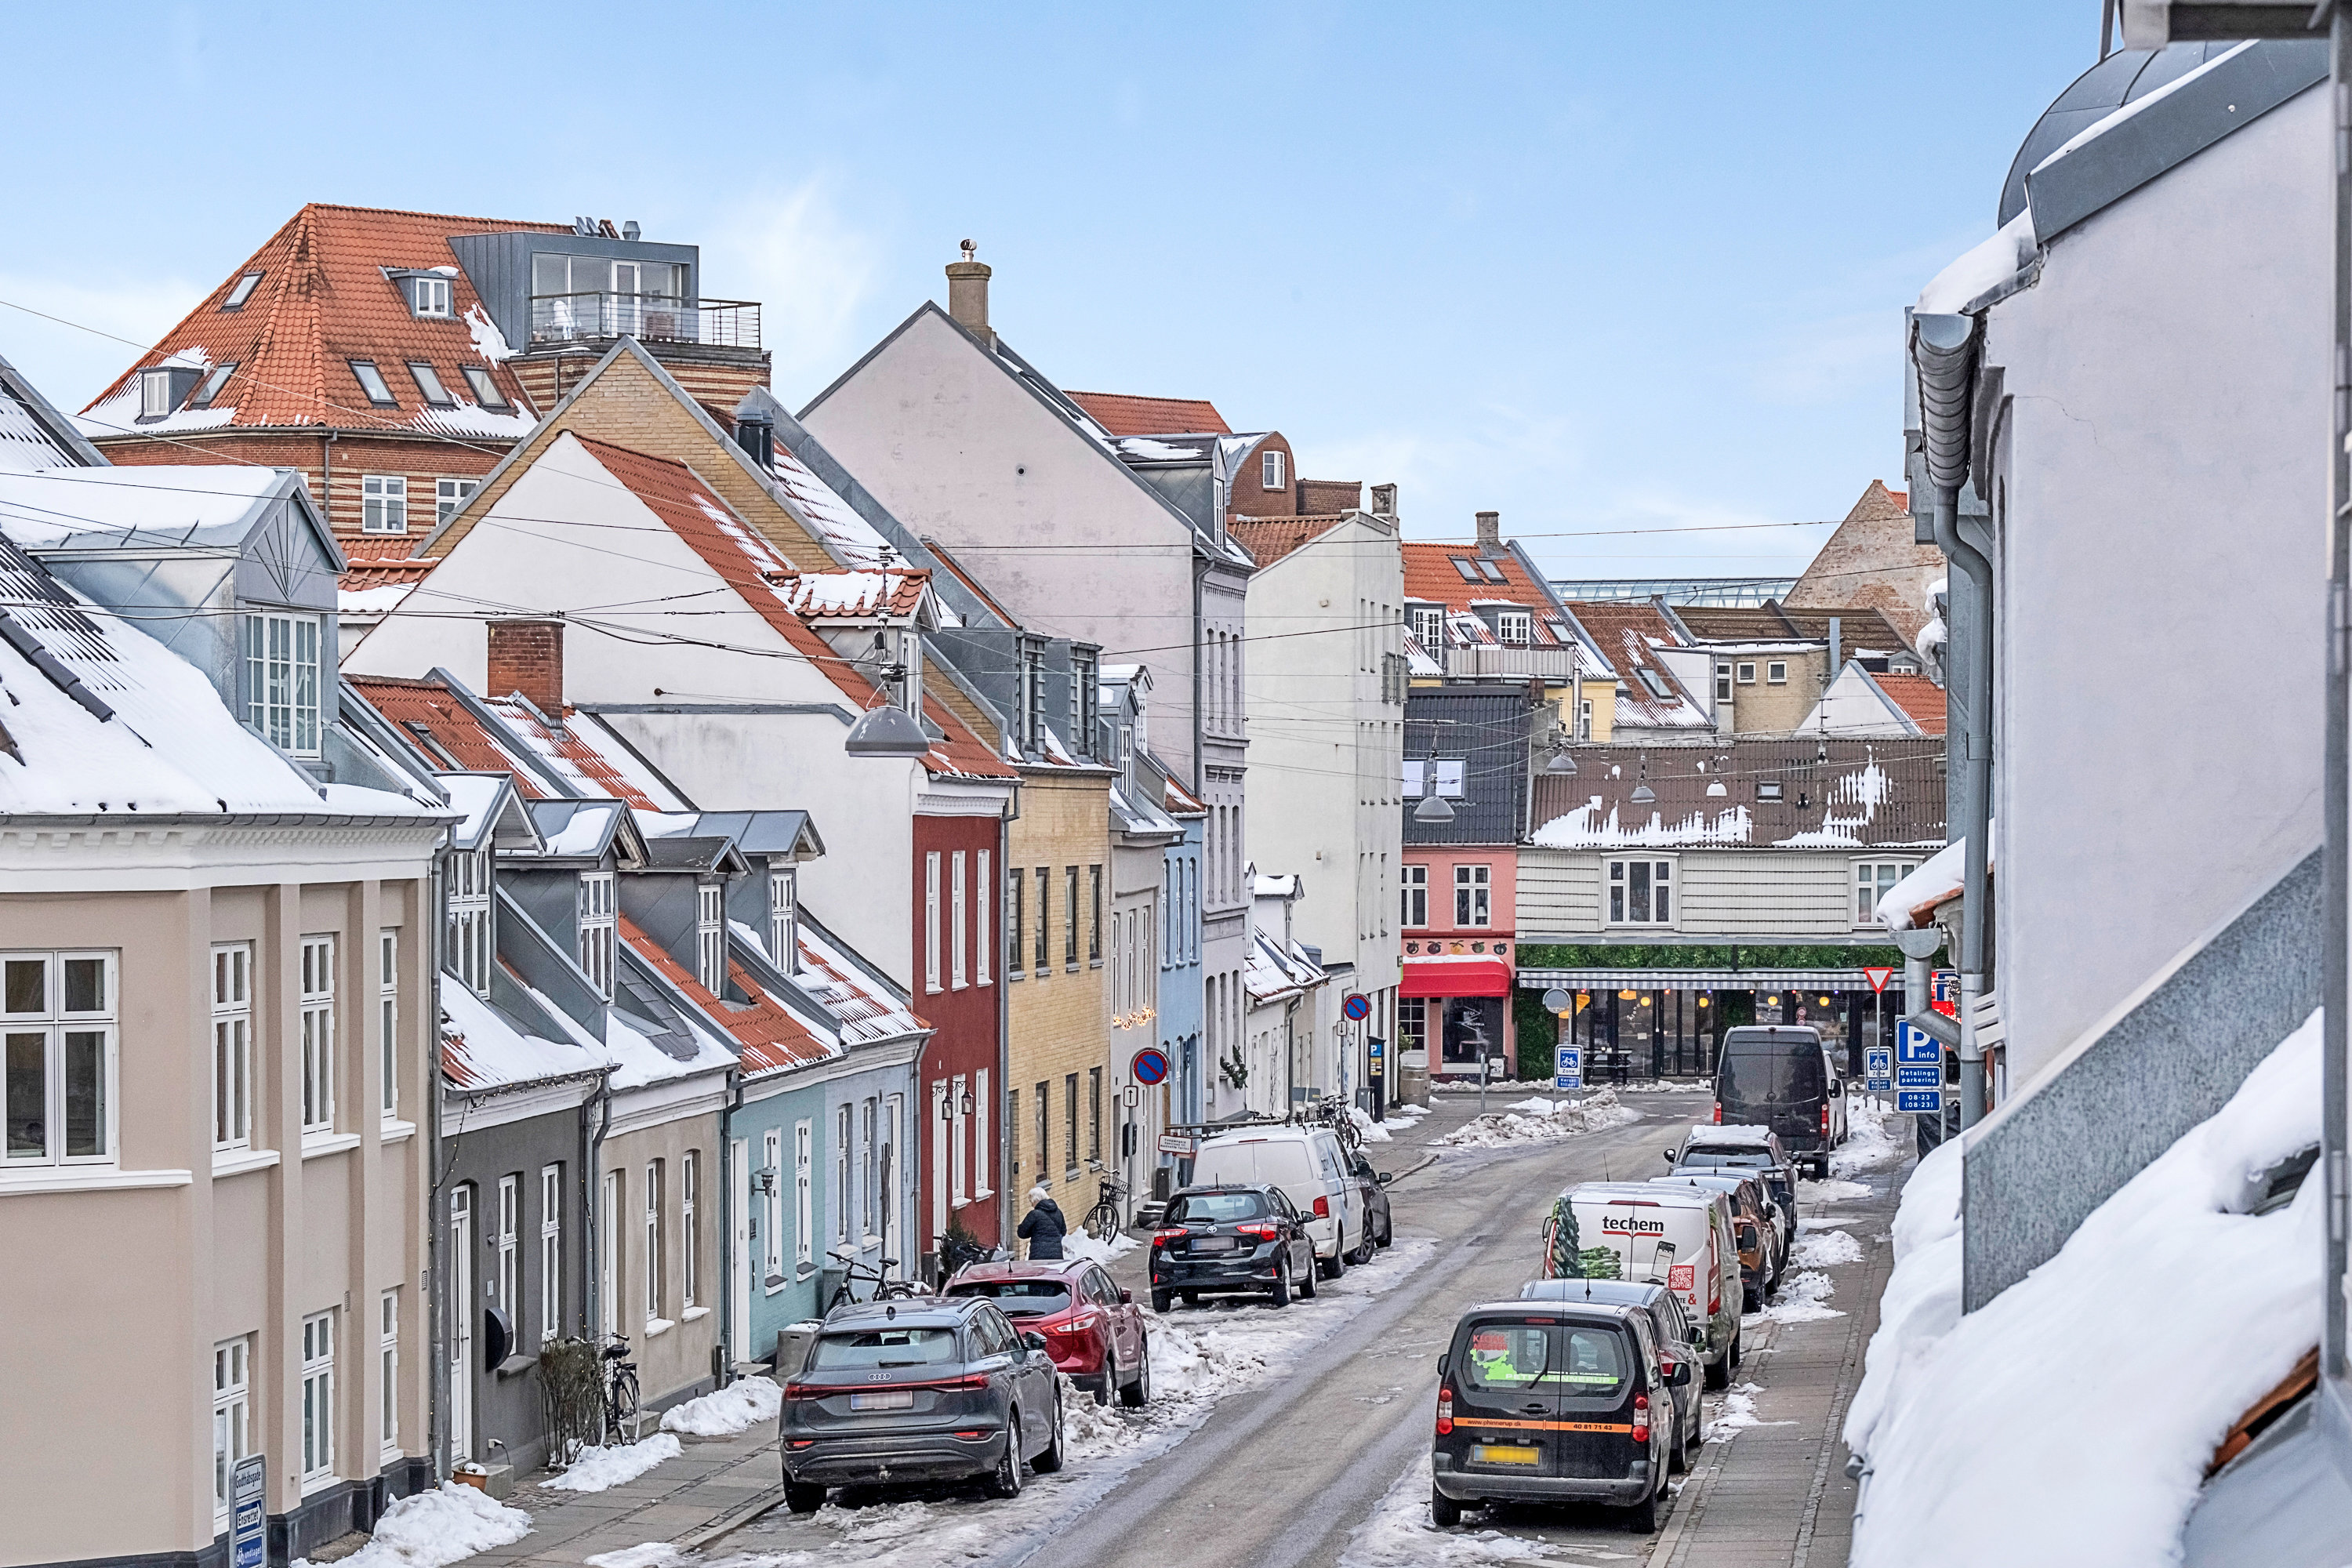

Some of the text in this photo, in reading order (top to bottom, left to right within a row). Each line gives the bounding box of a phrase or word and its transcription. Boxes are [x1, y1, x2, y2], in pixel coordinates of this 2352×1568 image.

[1907, 1025, 1930, 1058] P
[1370, 1045, 1377, 1054] P
[1602, 1215, 1664, 1232] techem
[1688, 1293, 1697, 1305] &
[1548, 1374, 1611, 1383] HINNERUP
[236, 1468, 261, 1489] Godthåbsgade
[238, 1510, 259, 1526] Ensrettet
[244, 1544, 262, 1559] undtaget
